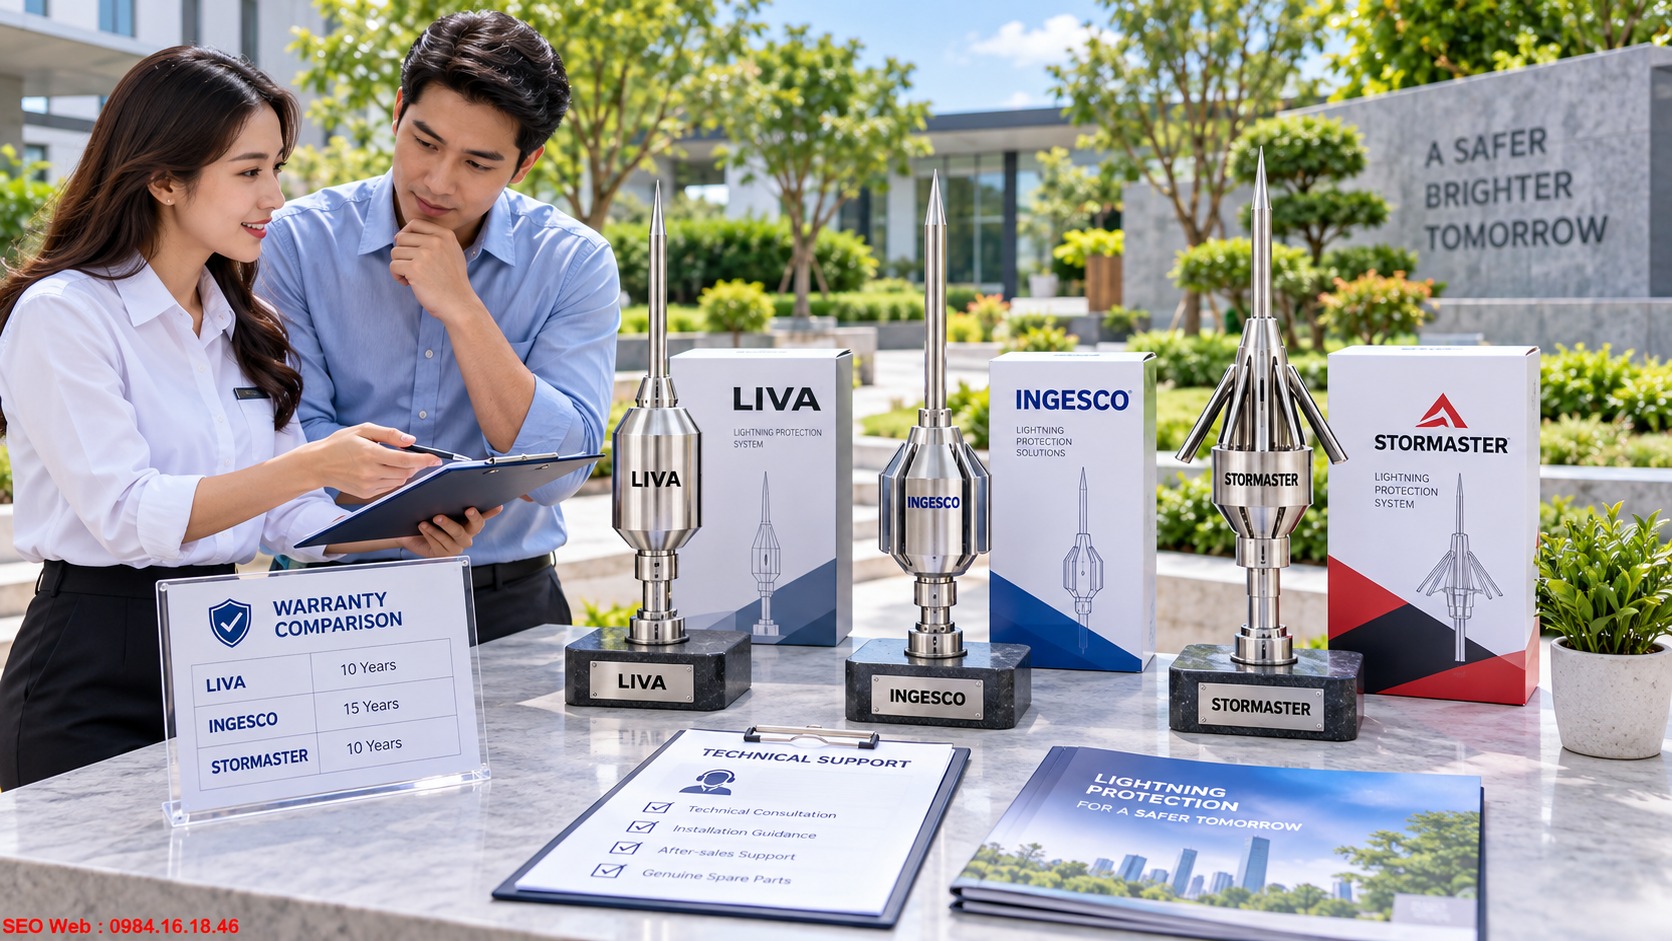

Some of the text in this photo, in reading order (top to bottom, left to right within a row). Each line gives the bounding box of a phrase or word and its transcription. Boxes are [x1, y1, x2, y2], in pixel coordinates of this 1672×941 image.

[1425, 127, 1547, 168] A SAFER
[1425, 171, 1572, 209] BRIGHTER
[1425, 215, 1608, 251] TOMORROW
[733, 386, 821, 411] LIVA
[733, 428, 822, 438] LIGHTNING PROTECTION
[1016, 426, 1064, 435] LIGHTNING
[733, 440, 764, 449] SYSTEM
[1016, 437, 1072, 446] PROTECTION
[1374, 434, 1508, 454] STORMASTER
[1016, 448, 1066, 458] SOLUTIONS
[631, 470, 681, 488] LIVA
[1224, 471, 1299, 488] STORMASTER
[1374, 472, 1430, 483] LIGHTNING
[1374, 485, 1438, 496] PROTECTION
[907, 495, 960, 510] INGESCO
[1374, 498, 1416, 509] SYSTEM
[272, 591, 388, 617] WARRANTY
[274, 611, 403, 638] COMPARISON
[205, 658, 397, 693] LIVA 10 Years
[617, 673, 667, 691] LIVA
[889, 687, 966, 707] INGESCO
[208, 697, 400, 734] INGESCO 15 Years
[1211, 697, 1311, 716] STORMASTER
[211, 736, 403, 775] STORMASTER 10 Years
[702, 747, 912, 769] TECHNICAL SUPPORT
[1093, 773, 1227, 799] LIGHTNING
[1084, 784, 1240, 813] PROTECTION
[687, 805, 837, 820] Technical Consultation
[1076, 800, 1303, 832] FOR A SAFER TOMORROW
[672, 824, 817, 840] Installation Guidance
[658, 845, 796, 862] After-sales Support
[642, 868, 792, 886] Genuine Spare Parts
